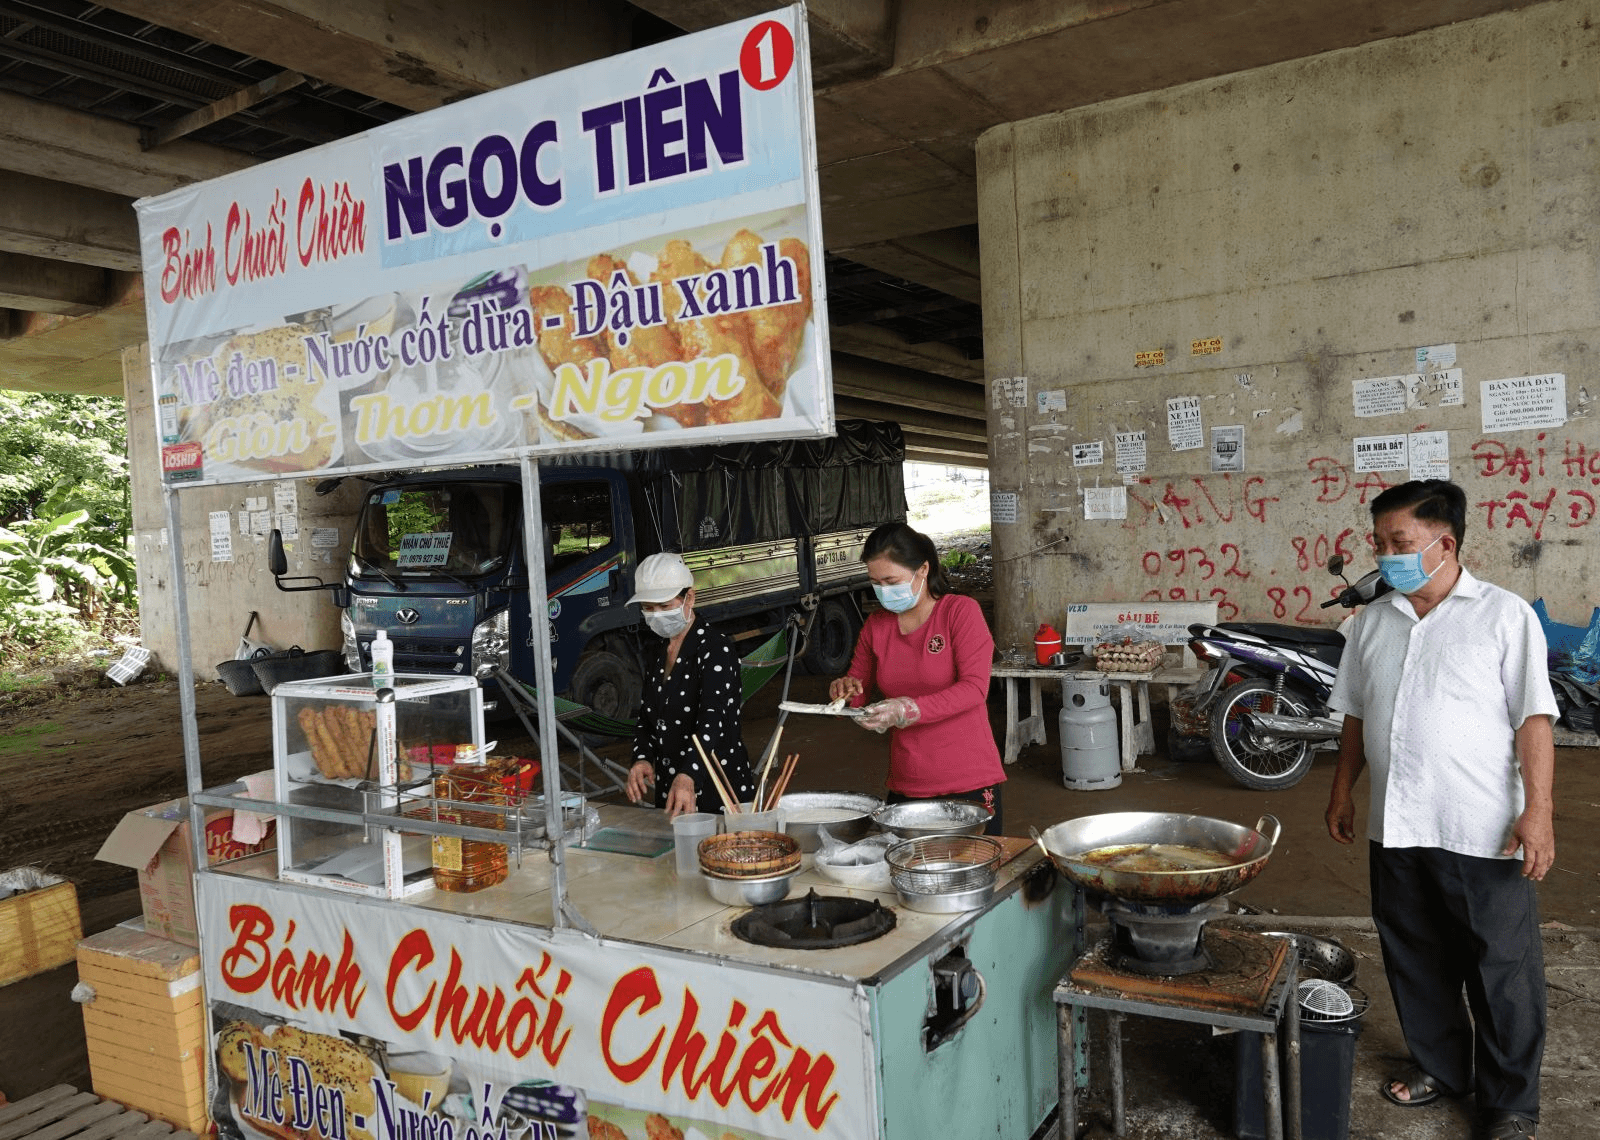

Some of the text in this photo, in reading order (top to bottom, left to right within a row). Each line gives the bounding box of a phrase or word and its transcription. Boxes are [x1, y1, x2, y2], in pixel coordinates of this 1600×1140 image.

[383, 26, 778, 238] NGỌC TIÊN 1
[160, 176, 367, 304] Bánh Chuối Chiên
[177, 354, 221, 405] Mè
[228, 353, 277, 398] đen
[305, 324, 391, 383] Nước
[400, 297, 450, 367] cốt
[462, 304, 534, 357] dừa
[572, 272, 664, 346] Đậu
[677, 244, 798, 319] xanh
[1489, 375, 1556, 391] BÁN NHÀ ĐẤT
[350, 391, 495, 441] Thơm
[553, 355, 742, 421] Ngon
[1168, 402, 1180, 412] XE
[1170, 411, 1182, 421] XE
[1116, 434, 1128, 443] XE
[1357, 438, 1403, 452] BÁN NHÀ ĐẤT
[1471, 432, 1546, 484] ĐẠI
[1476, 487, 1557, 540] TÂY
[401, 537, 419, 552] NHẬN
[433, 534, 451, 549] THUÊ
[409, 554, 422, 563] 0979
[1142, 542, 1251, 581] 0932
[1068, 604, 1088, 613] VLXD
[1117, 609, 1160, 624] SÁU BÉ
[221, 904, 368, 1020] Bánh
[386, 928, 573, 1069] Chuối
[601, 966, 841, 1131] Chiên
[244, 1042, 285, 1123] Mè
[287, 1057, 348, 1139] Đen
